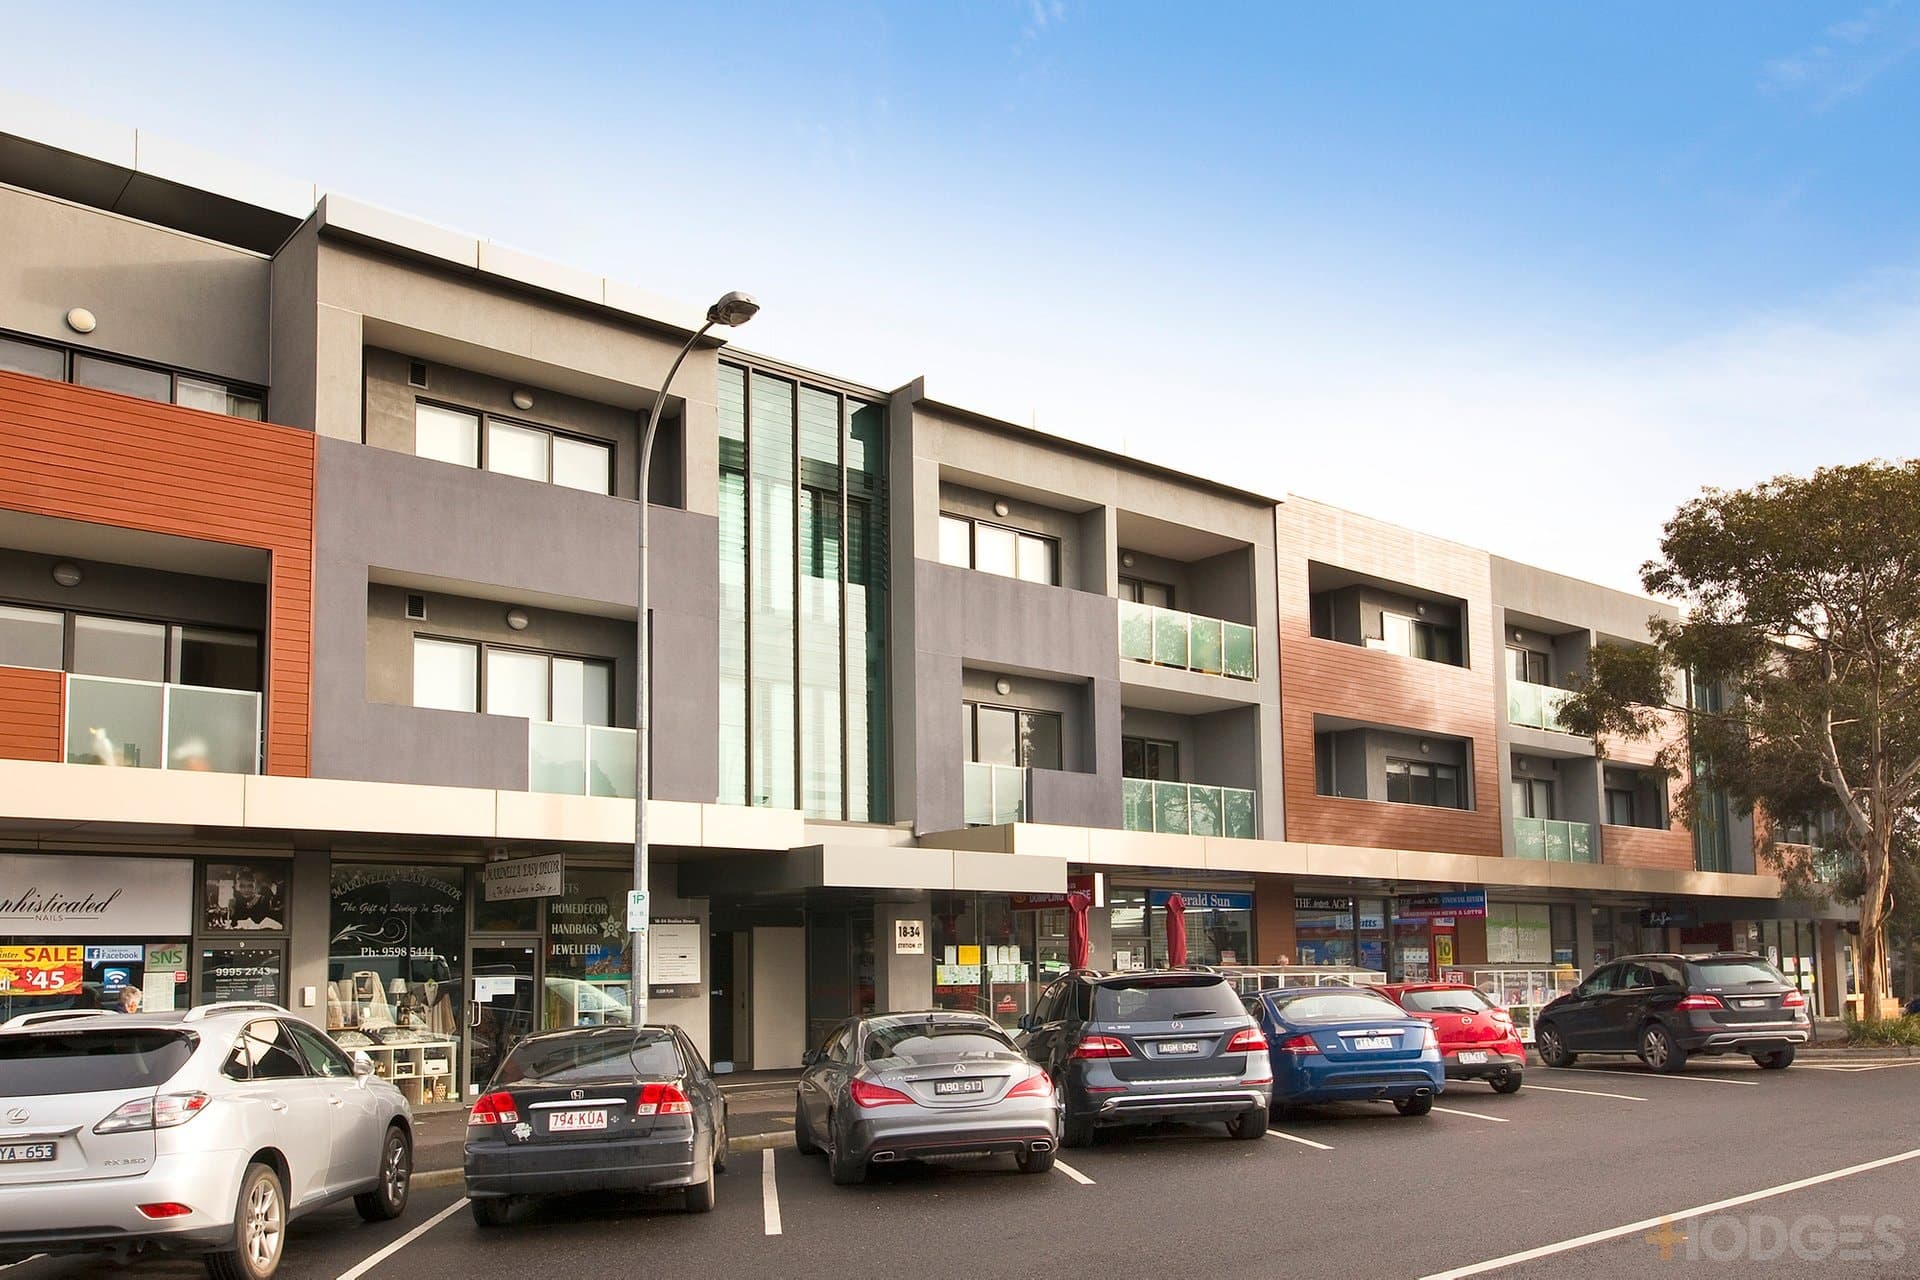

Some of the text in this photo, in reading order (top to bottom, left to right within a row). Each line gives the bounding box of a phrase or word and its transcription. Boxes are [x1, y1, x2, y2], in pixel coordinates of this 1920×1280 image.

[632, 894, 645, 905] 1P
[1182, 894, 1231, 908] erald Sun
[552, 903, 608, 915] HOMEDECOR
[551, 923, 599, 935] HANDBAGS
[898, 926, 920, 937] 18-34
[24, 947, 78, 962] SALE
[360, 947, 380, 957] Ph:
[381, 947, 407, 957] 9598
[551, 943, 601, 955] JEWELLERY
[102, 951, 138, 959] Facebook
[150, 951, 182, 965] SNS
[216, 968, 242, 976] 9995
[104, 1158, 147, 1167] RX 350
